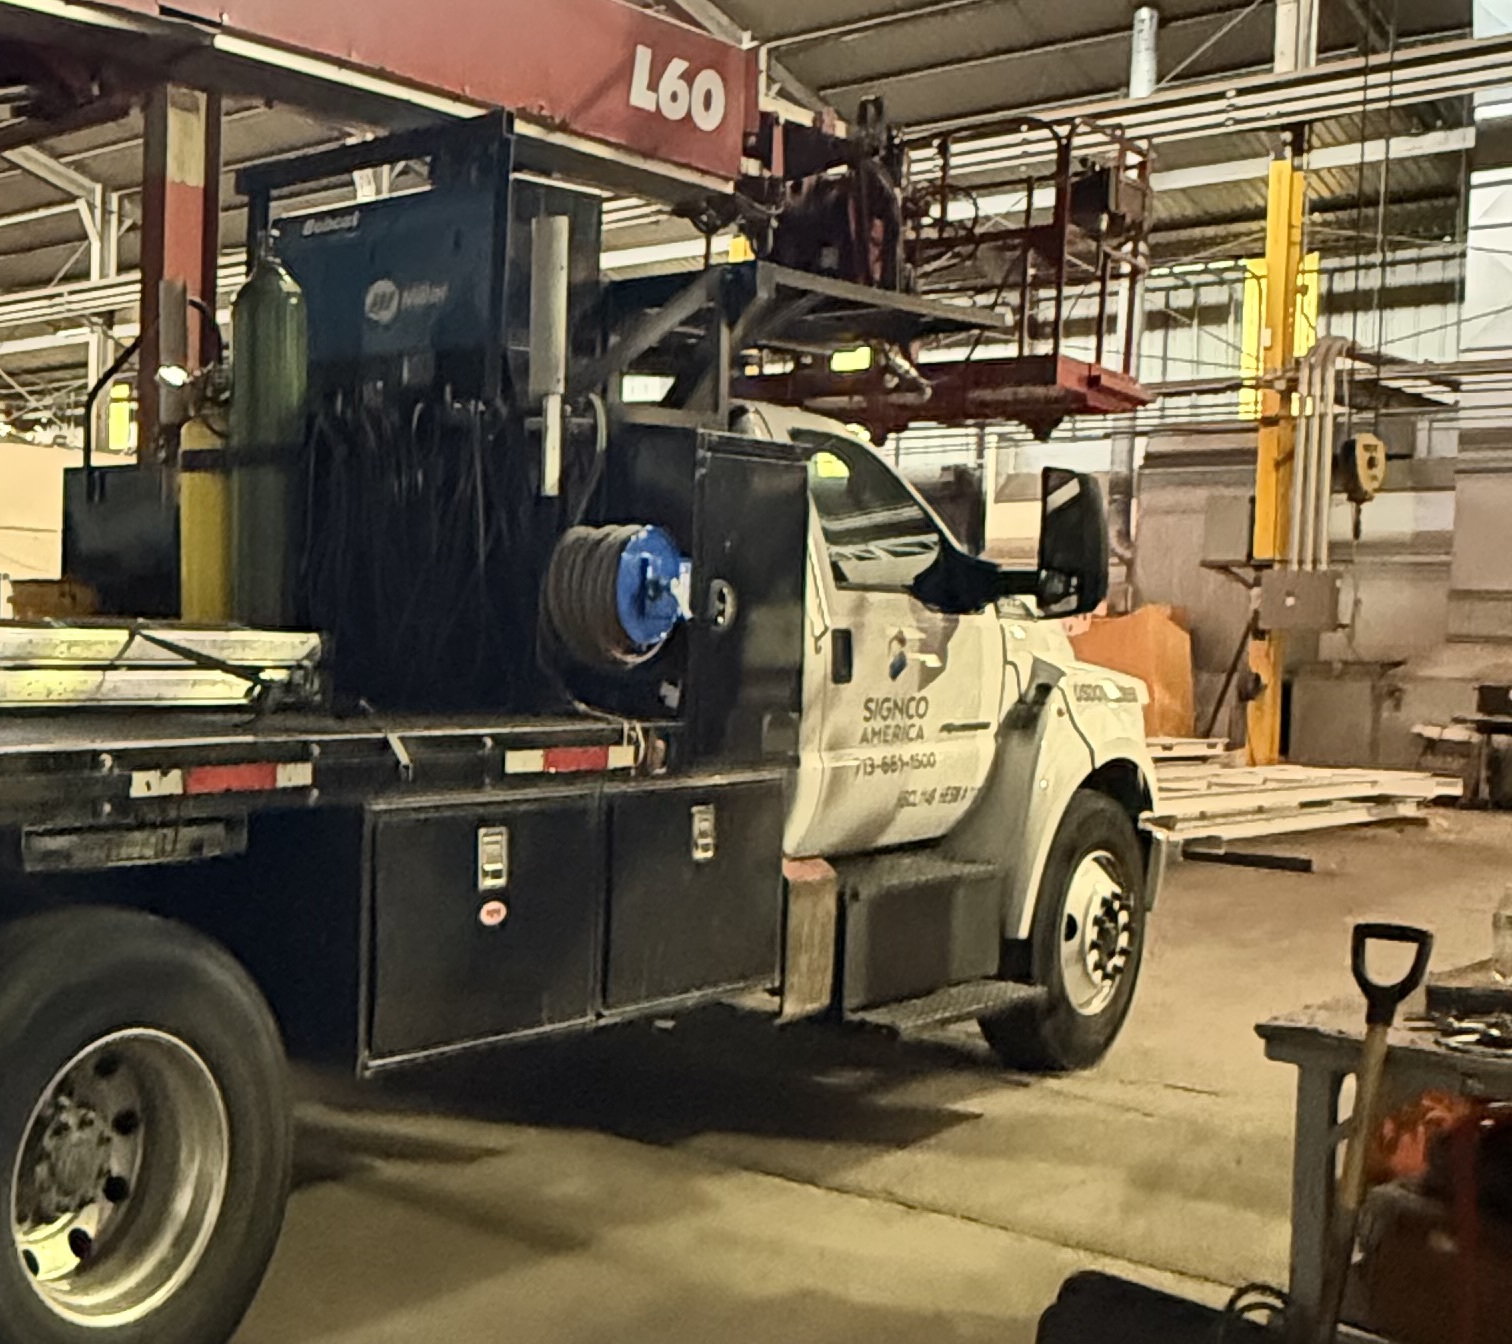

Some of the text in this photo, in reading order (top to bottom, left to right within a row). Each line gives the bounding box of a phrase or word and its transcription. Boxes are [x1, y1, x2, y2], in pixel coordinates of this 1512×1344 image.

[629, 44, 726, 132] L60
[863, 695, 929, 722] SIGNCO
[859, 723, 925, 745] AMERICA
